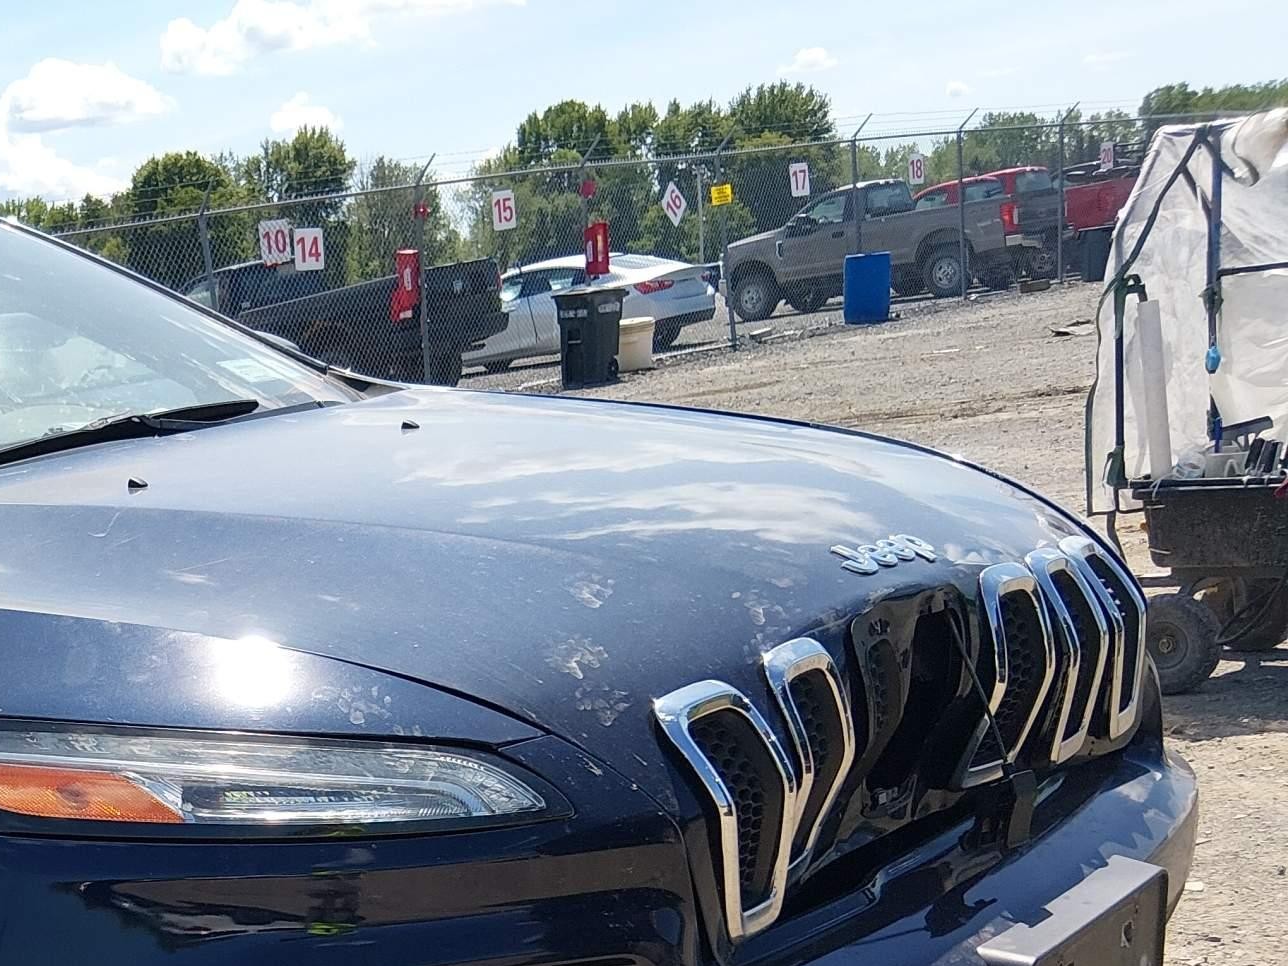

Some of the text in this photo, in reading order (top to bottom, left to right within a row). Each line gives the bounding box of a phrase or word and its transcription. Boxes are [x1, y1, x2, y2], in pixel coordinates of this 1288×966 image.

[1102, 147, 1112, 164] 20
[792, 169, 806, 190] 17
[910, 159, 923, 179] 18
[494, 197, 513, 223] 15
[666, 189, 682, 217] 16
[263, 229, 287, 255] 10
[296, 236, 321, 263] 14
[830, 534, 937, 575] Jeep
